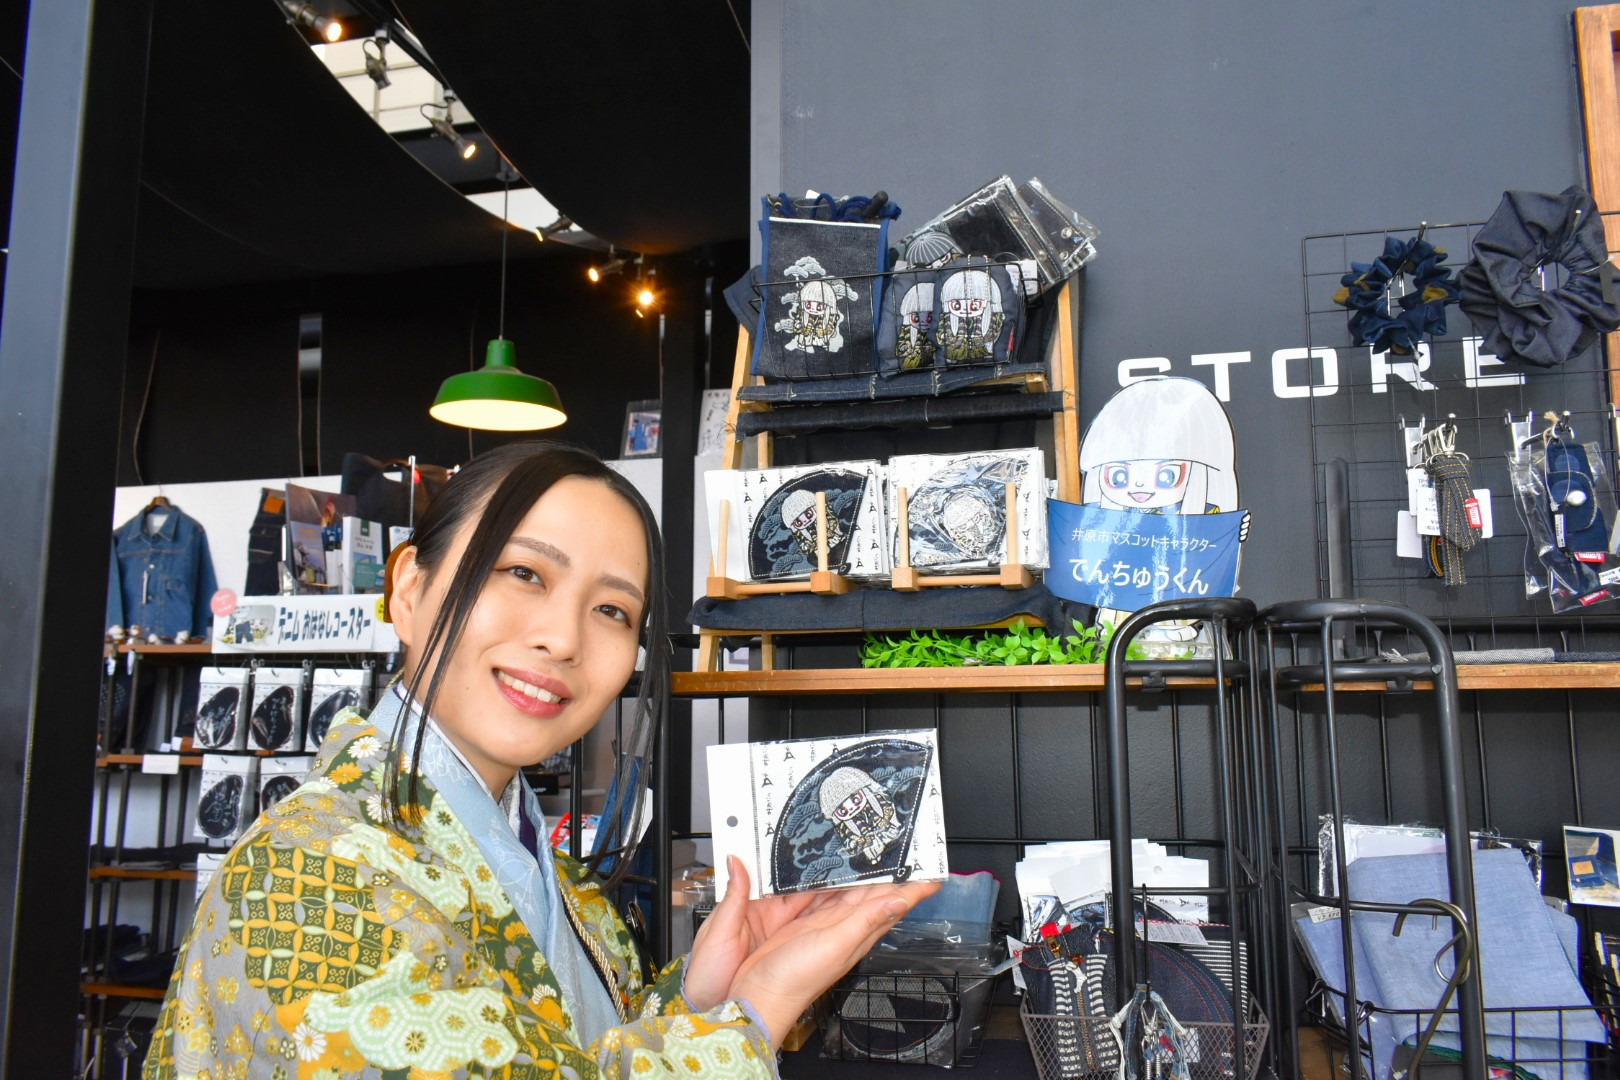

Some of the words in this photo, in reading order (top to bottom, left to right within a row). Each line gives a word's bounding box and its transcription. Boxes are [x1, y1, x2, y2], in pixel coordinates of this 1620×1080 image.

[1071, 529, 1217, 553] 井原市マスコットキャラクター
[1069, 559, 1209, 595] でんちゅうくん
